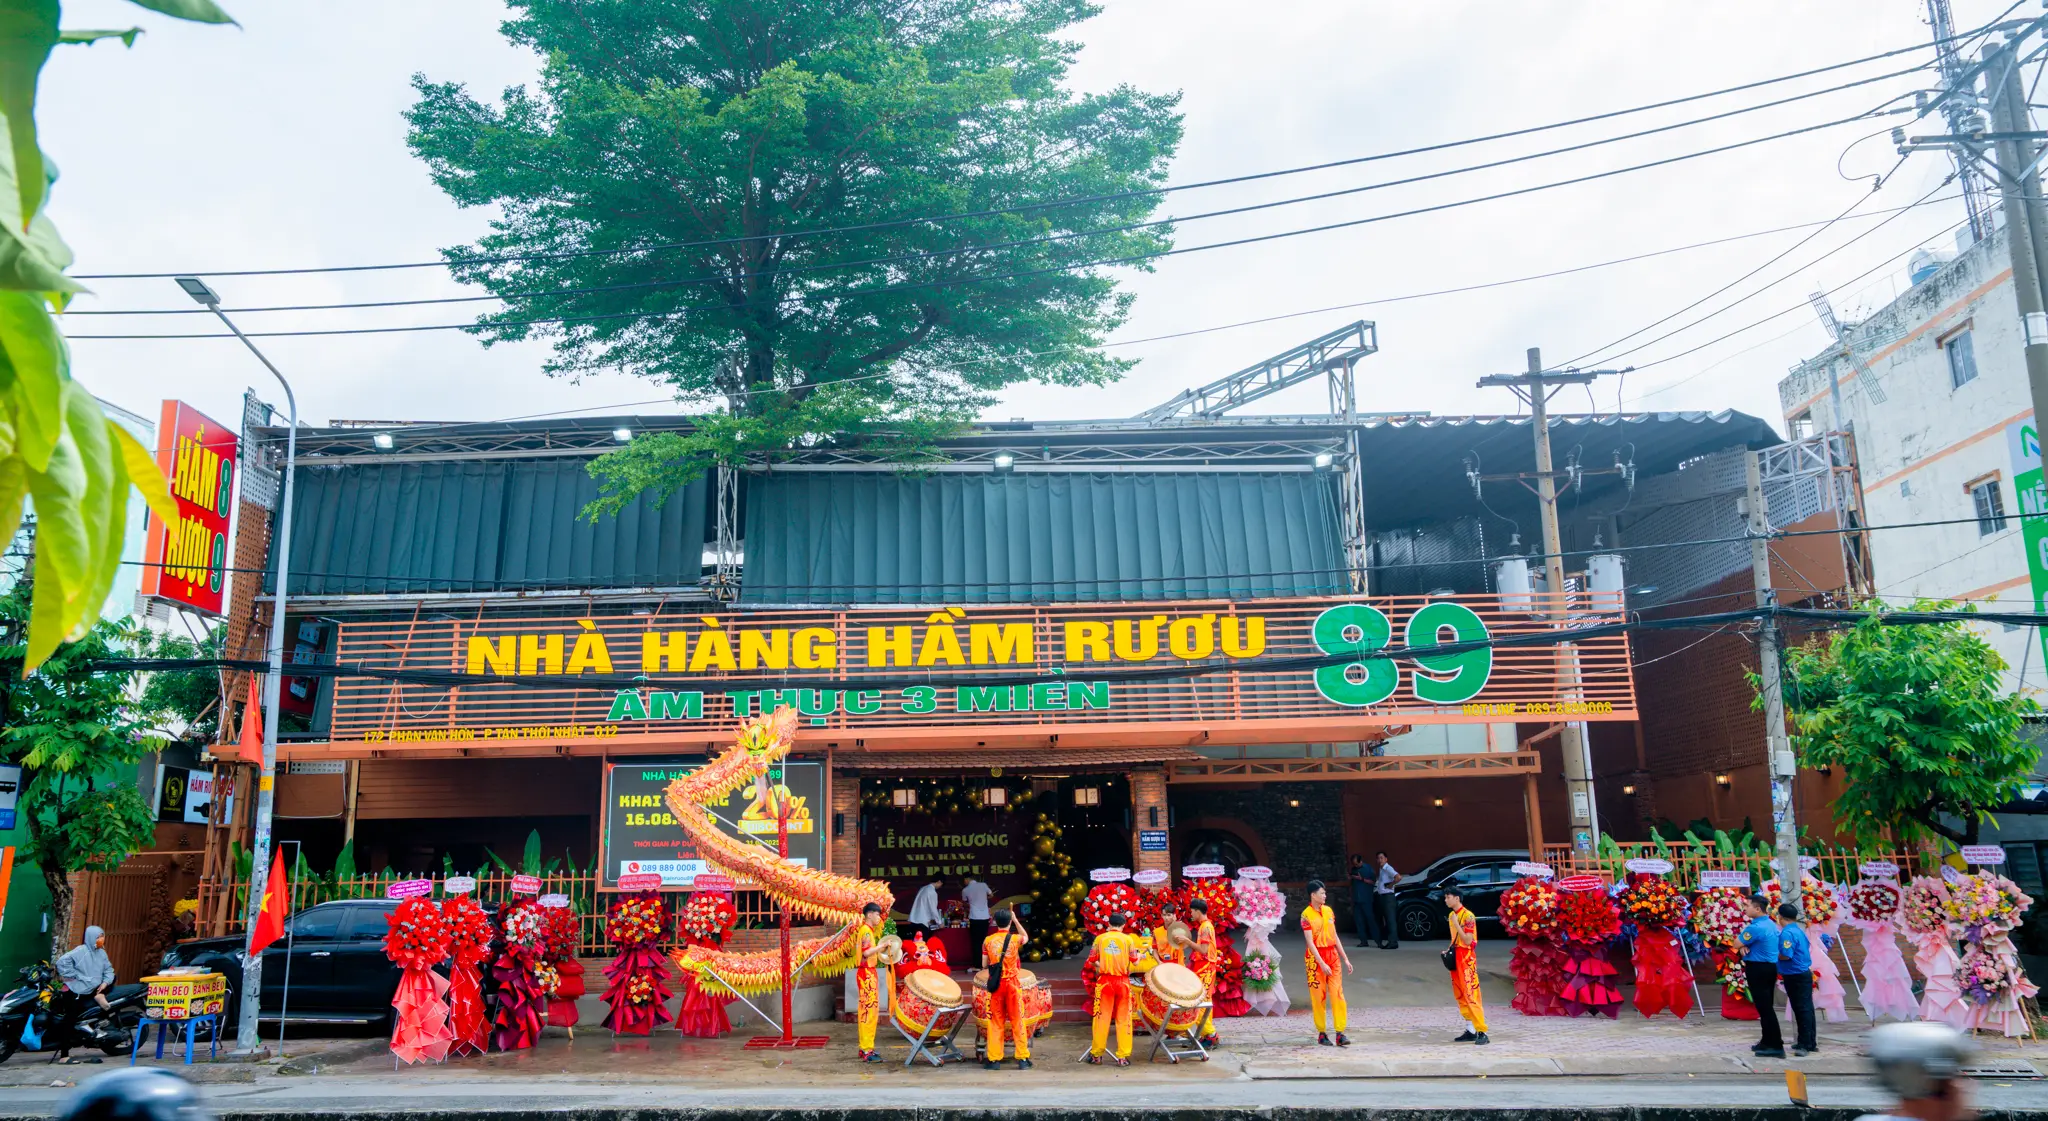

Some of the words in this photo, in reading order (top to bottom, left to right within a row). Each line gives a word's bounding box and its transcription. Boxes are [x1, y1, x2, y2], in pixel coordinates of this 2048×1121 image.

[175, 424, 219, 512] HẦM
[466, 619, 614, 676] NHÀ
[641, 616, 837, 672] HÀNG
[867, 607, 1034, 667] HẦM
[1312, 602, 1493, 706] 89
[901, 685, 937, 713] 3
[1463, 703, 1522, 717] HOTLINE:
[364, 731, 384, 744] 172
[389, 730, 421, 743] PHAN
[642, 769, 666, 781] NHÀ
[619, 795, 662, 808] KHAI
[652, 840, 670, 848] GIAN
[878, 828, 895, 848] LỄ
[899, 835, 939, 848] KHAI
[941, 832, 1009, 848] TRƯƠNG
[677, 851, 695, 859] Liên
[642, 864, 657, 872] 089
[659, 864, 675, 872] 889
[676, 864, 697, 872] 0008
[990, 864, 1016, 875] 89
[165, 1008, 186, 1017] 15K
